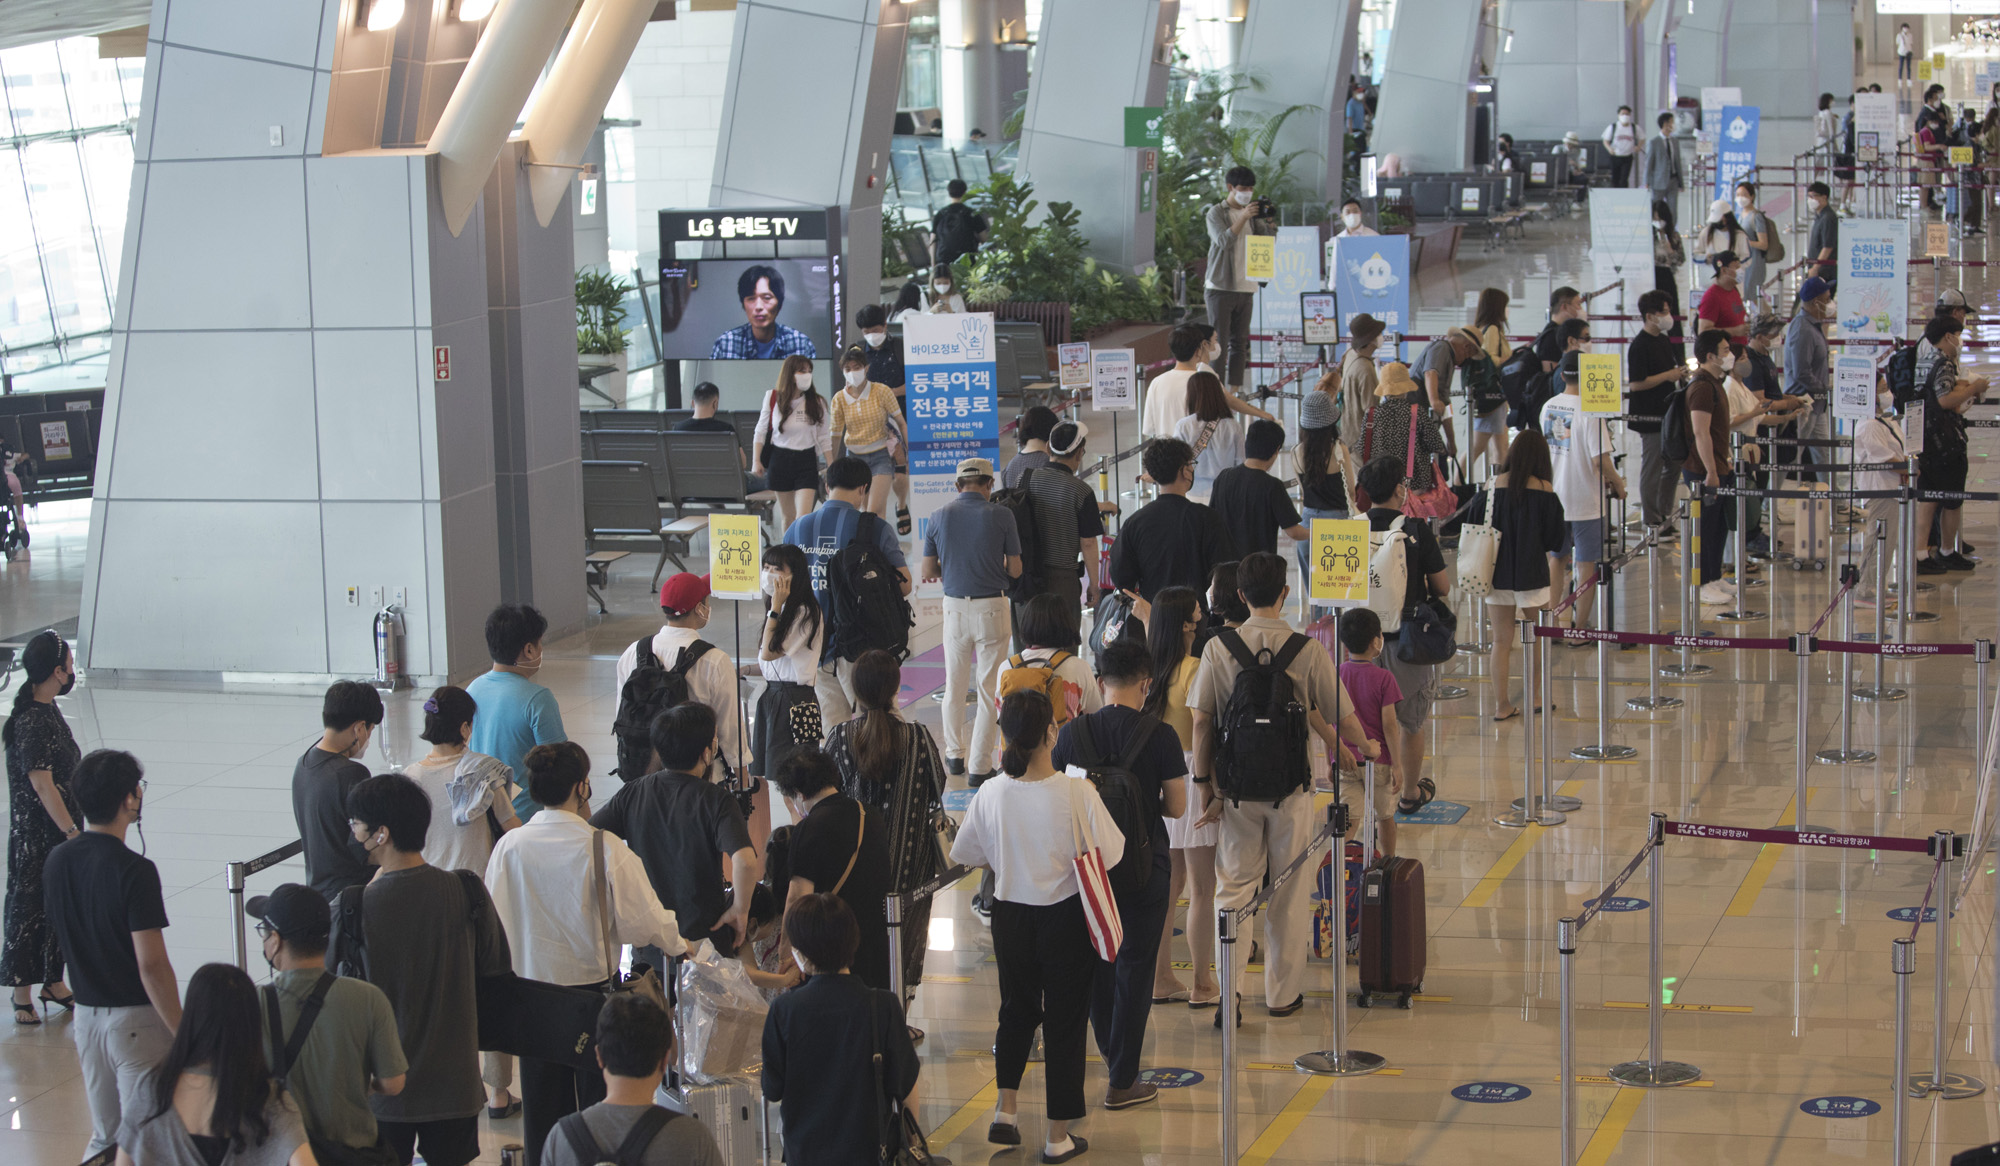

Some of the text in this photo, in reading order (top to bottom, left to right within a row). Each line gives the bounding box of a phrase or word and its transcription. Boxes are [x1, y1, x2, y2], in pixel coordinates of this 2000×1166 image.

[687, 216, 798, 238] LG 올레드 TV
[1851, 244, 1895, 256] 손하나로
[1850, 258, 1895, 270] 탑승하자
[969, 336, 980, 348] 손
[911, 344, 960, 355] 바이오정보
[911, 371, 990, 394] 등록여객
[912, 396, 992, 418] 전용통로
[1716, 487, 1736, 496] KAC
[1809, 491, 1828, 499] KAC
[1924, 490, 1944, 499] KAC
[717, 528, 730, 536] 함께
[1320, 533, 1362, 542] 함께 지켜요!
[1563, 629, 1619, 640] KAC 한국공항공사
[1674, 636, 1730, 647] KAC 한국공항공사
[1881, 644, 1939, 653] KAC 한국공항공사
[1677, 823, 1749, 838] KAC 한국공항공사
[1798, 833, 1870, 846] KAC 한국공항공사
